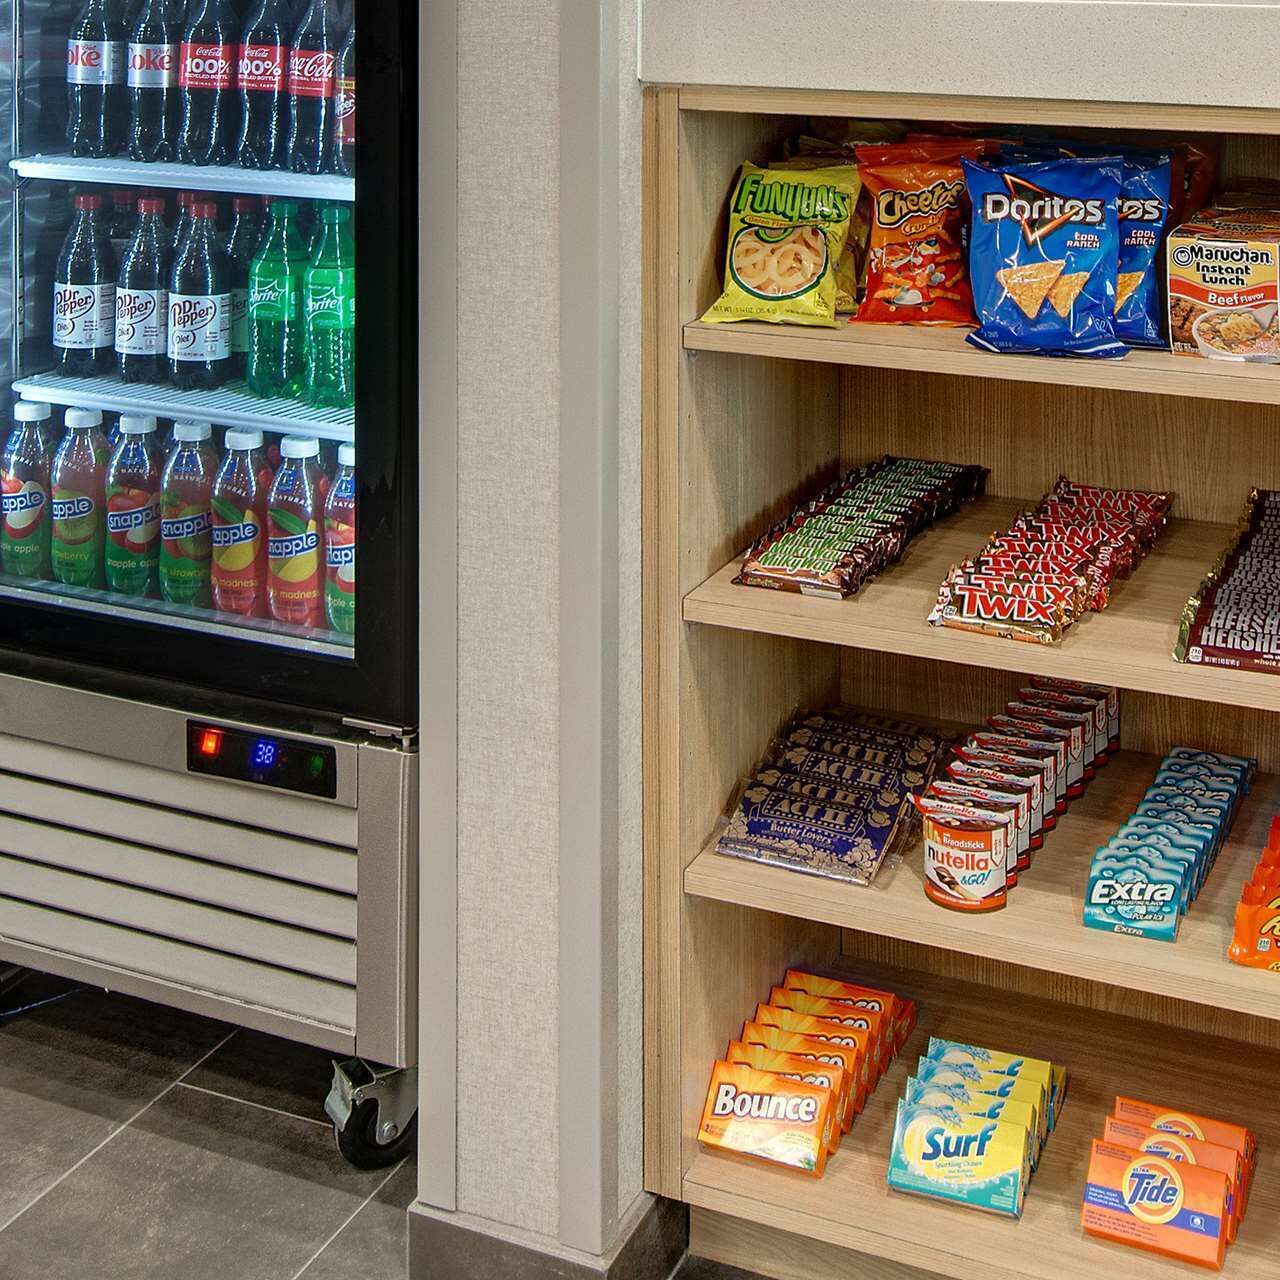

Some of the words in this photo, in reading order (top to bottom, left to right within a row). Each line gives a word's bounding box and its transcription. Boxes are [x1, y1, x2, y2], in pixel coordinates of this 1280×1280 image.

[878, 180, 965, 225] Cheetos
[985, 193, 1104, 222] Doritos
[1066, 239, 1100, 248] RANCH
[1124, 237, 1156, 246] RANCH
[1131, 229, 1156, 238] COOL
[1191, 245, 1270, 265] Maruchan
[1196, 261, 1251, 275] Instant
[1202, 274, 1245, 286] Lunch
[55, 291, 92, 316] Pepper
[63, 289, 79, 302] Dr
[123, 294, 139, 307] Dr
[1207, 292, 1239, 306] Beef
[1240, 292, 1265, 303] Flavor
[117, 296, 152, 320] Pepper
[171, 302, 213, 328] Pepper
[183, 300, 201, 314] Dr
[175, 334, 190, 344] Diet
[758, 552, 806, 574] Milky
[956, 585, 1056, 625] TWIX
[1254, 658, 1277, 667] whole
[255, 743, 274, 763] 38
[773, 799, 821, 819] ACT
[821, 807, 850, 825] II
[770, 821, 801, 836] Butter
[801, 826, 833, 845] Lovers
[943, 836, 984, 849] Breadsticks
[927, 844, 989, 871] nutella
[960, 868, 992, 886] &GO!
[1091, 879, 1175, 904] Extra
[1132, 912, 1153, 921] POLAR
[1114, 924, 1144, 935] Extra
[713, 1083, 817, 1122] Bounce
[921, 1123, 997, 1161] Surf
[1127, 1172, 1179, 1207] Tide
